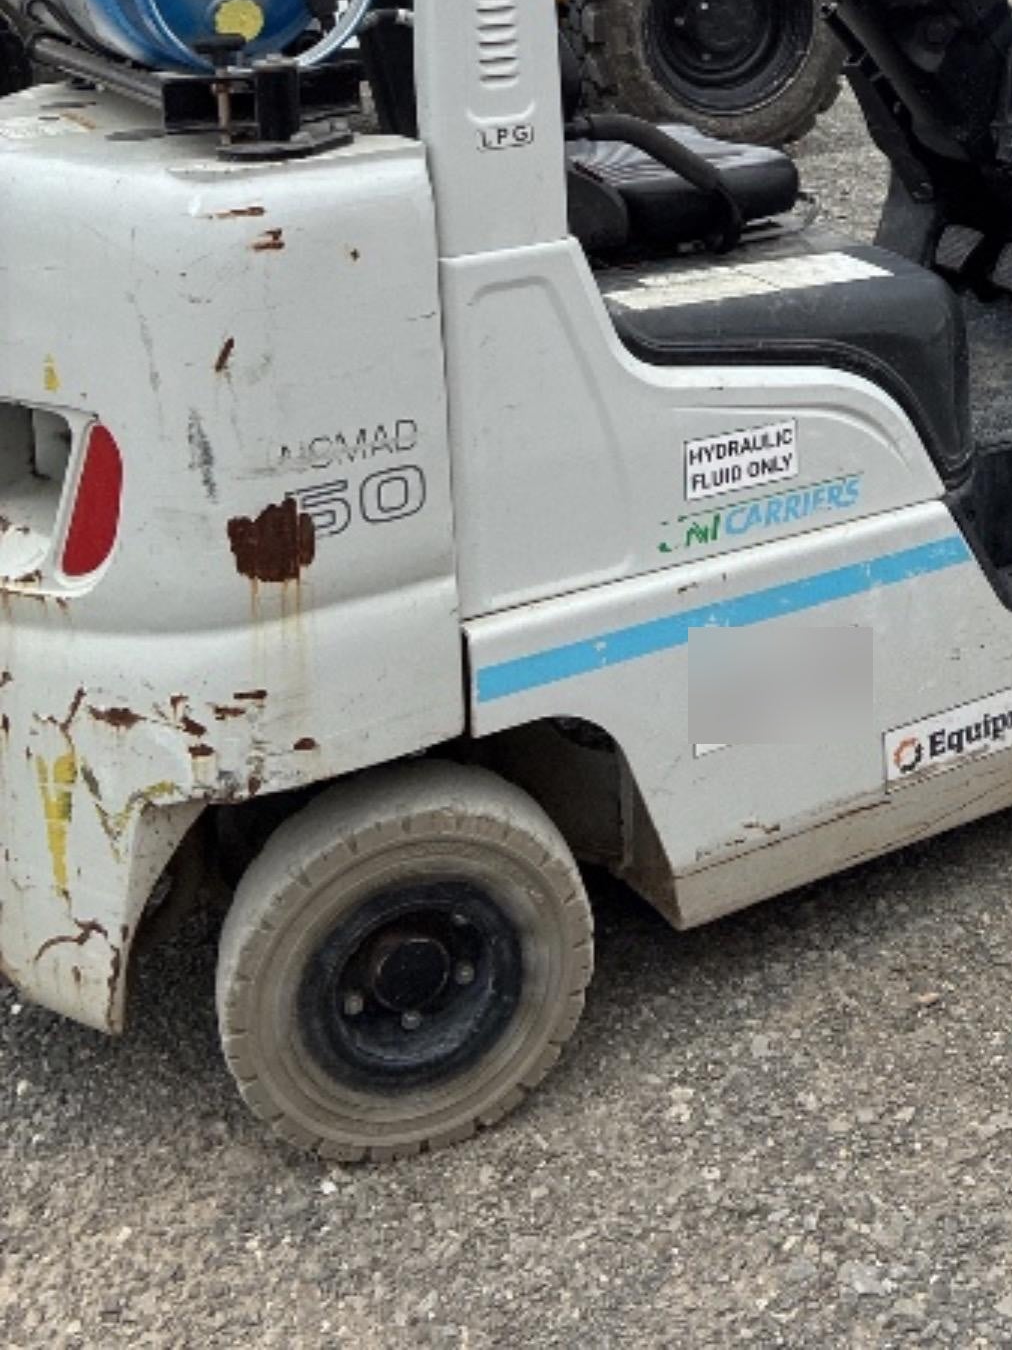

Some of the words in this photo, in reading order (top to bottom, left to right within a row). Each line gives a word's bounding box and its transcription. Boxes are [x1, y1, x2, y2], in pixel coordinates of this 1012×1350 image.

[480, 125, 529, 148] LPG
[689, 428, 793, 466] HYDRAULIC
[691, 465, 742, 492] FLUID
[746, 453, 793, 478] ONLY
[284, 465, 426, 540] 50
[657, 476, 861, 553] NICARRIERS
